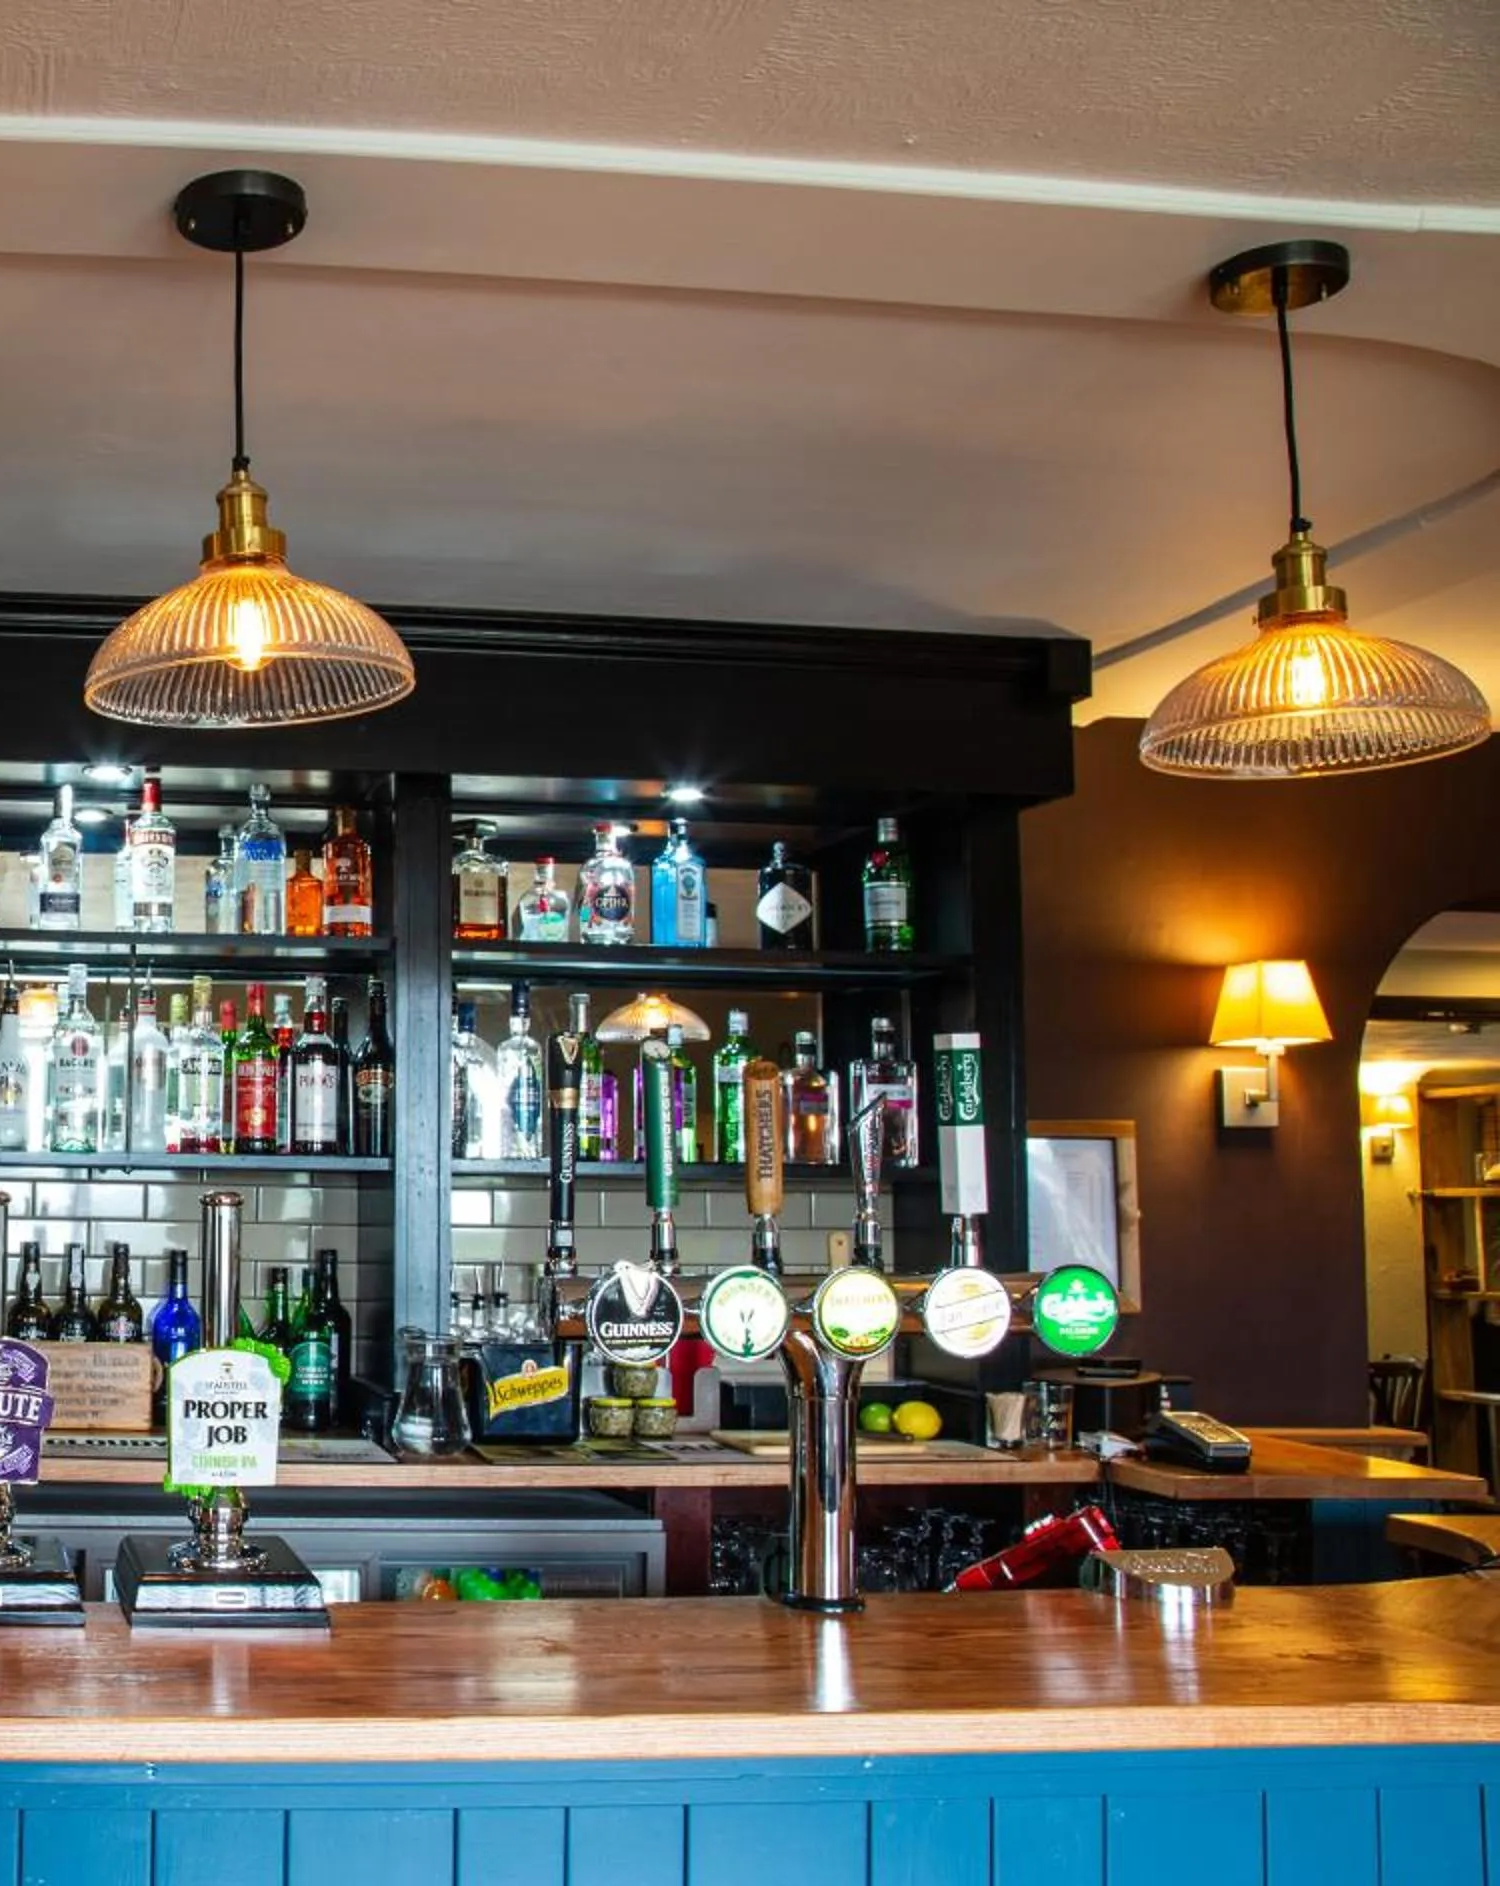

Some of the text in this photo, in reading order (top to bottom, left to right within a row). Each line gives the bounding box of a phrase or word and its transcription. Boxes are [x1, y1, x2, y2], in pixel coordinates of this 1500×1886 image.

[957, 1053, 980, 1121] Carlsberg
[756, 1088, 773, 1182] THATCHERS
[560, 1123, 575, 1184] GUINNESS
[1041, 1291, 1116, 1323] Carlsberg
[600, 1320, 674, 1338] GUINNESS
[490, 1376, 563, 1405] Schweppes
[183, 1399, 268, 1420] PROPER
[206, 1425, 248, 1448] JOB
